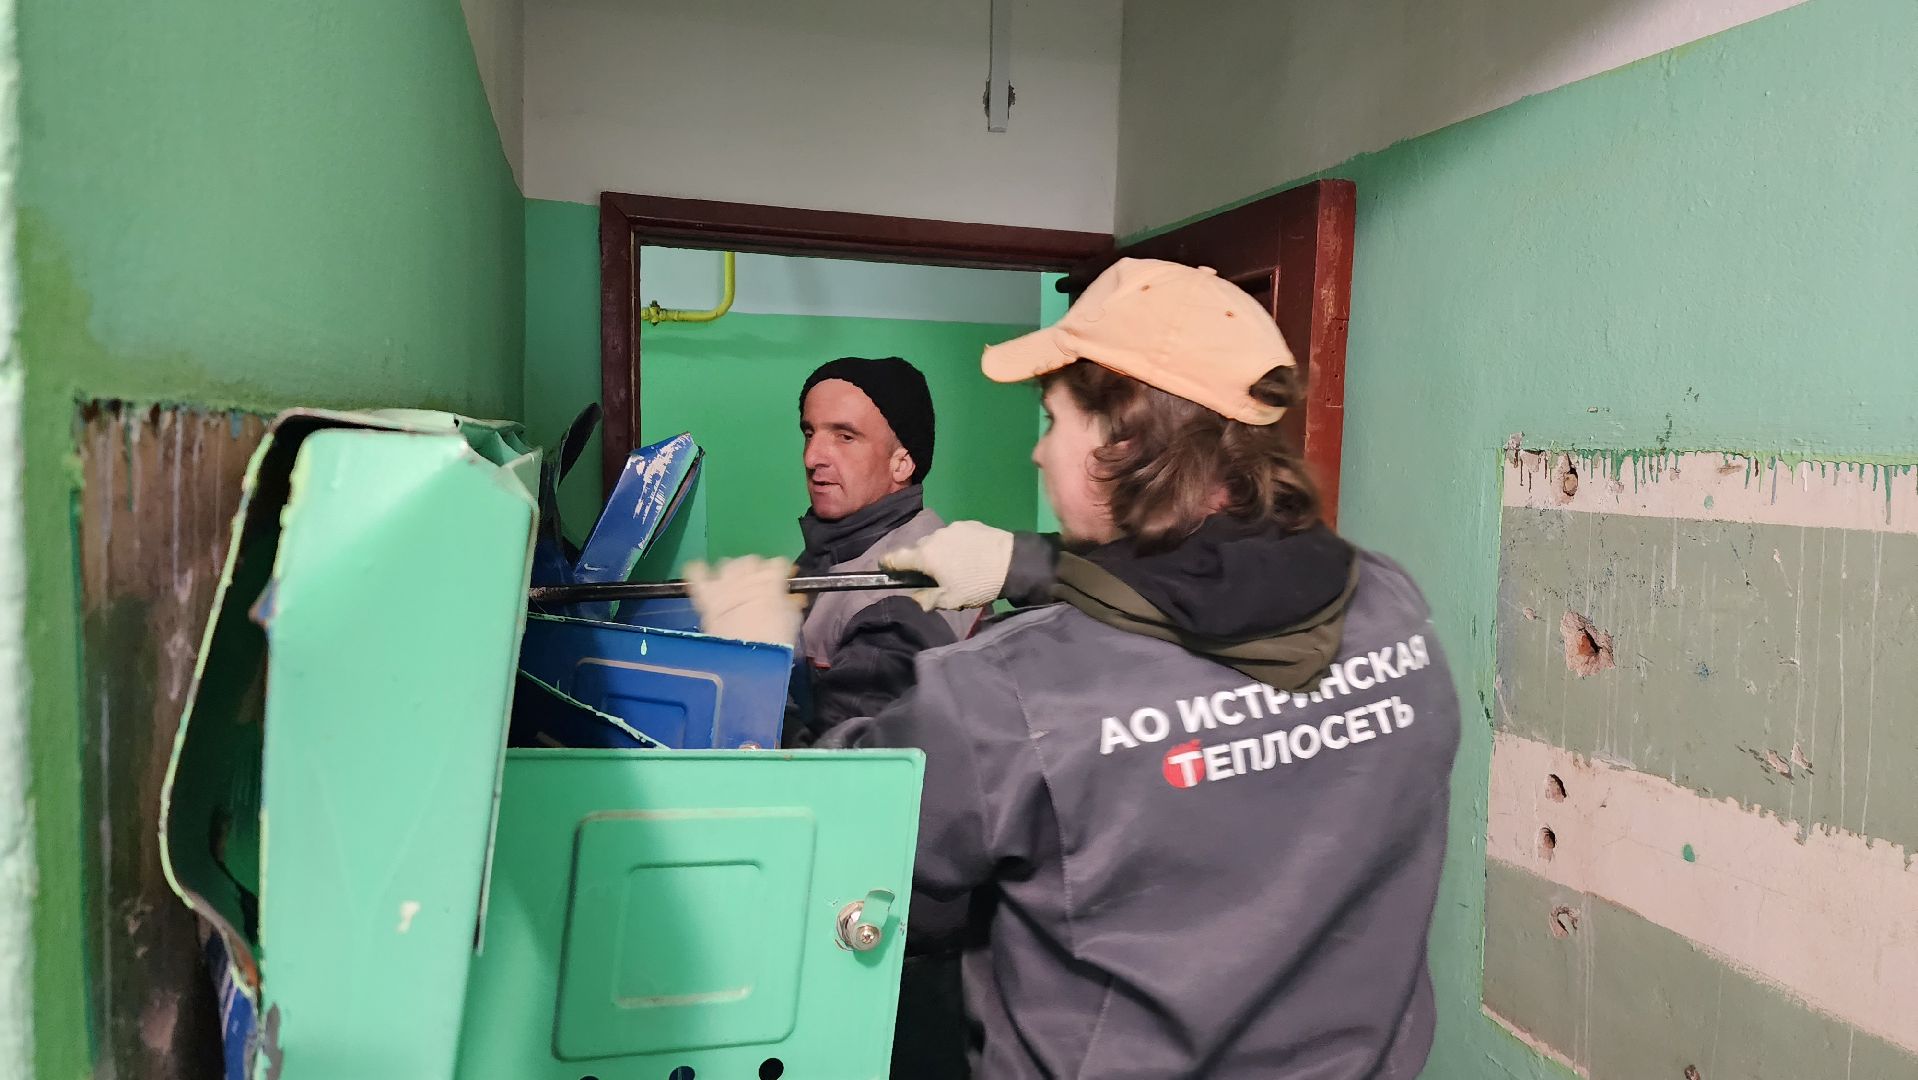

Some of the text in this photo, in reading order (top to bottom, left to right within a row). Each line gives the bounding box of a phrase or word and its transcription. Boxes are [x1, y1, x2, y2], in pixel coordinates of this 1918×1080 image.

[1100, 634, 1430, 755] АО ИСТРНСКАЯ
[1167, 695, 1415, 787] ТЕПЛОСЕТЬ
